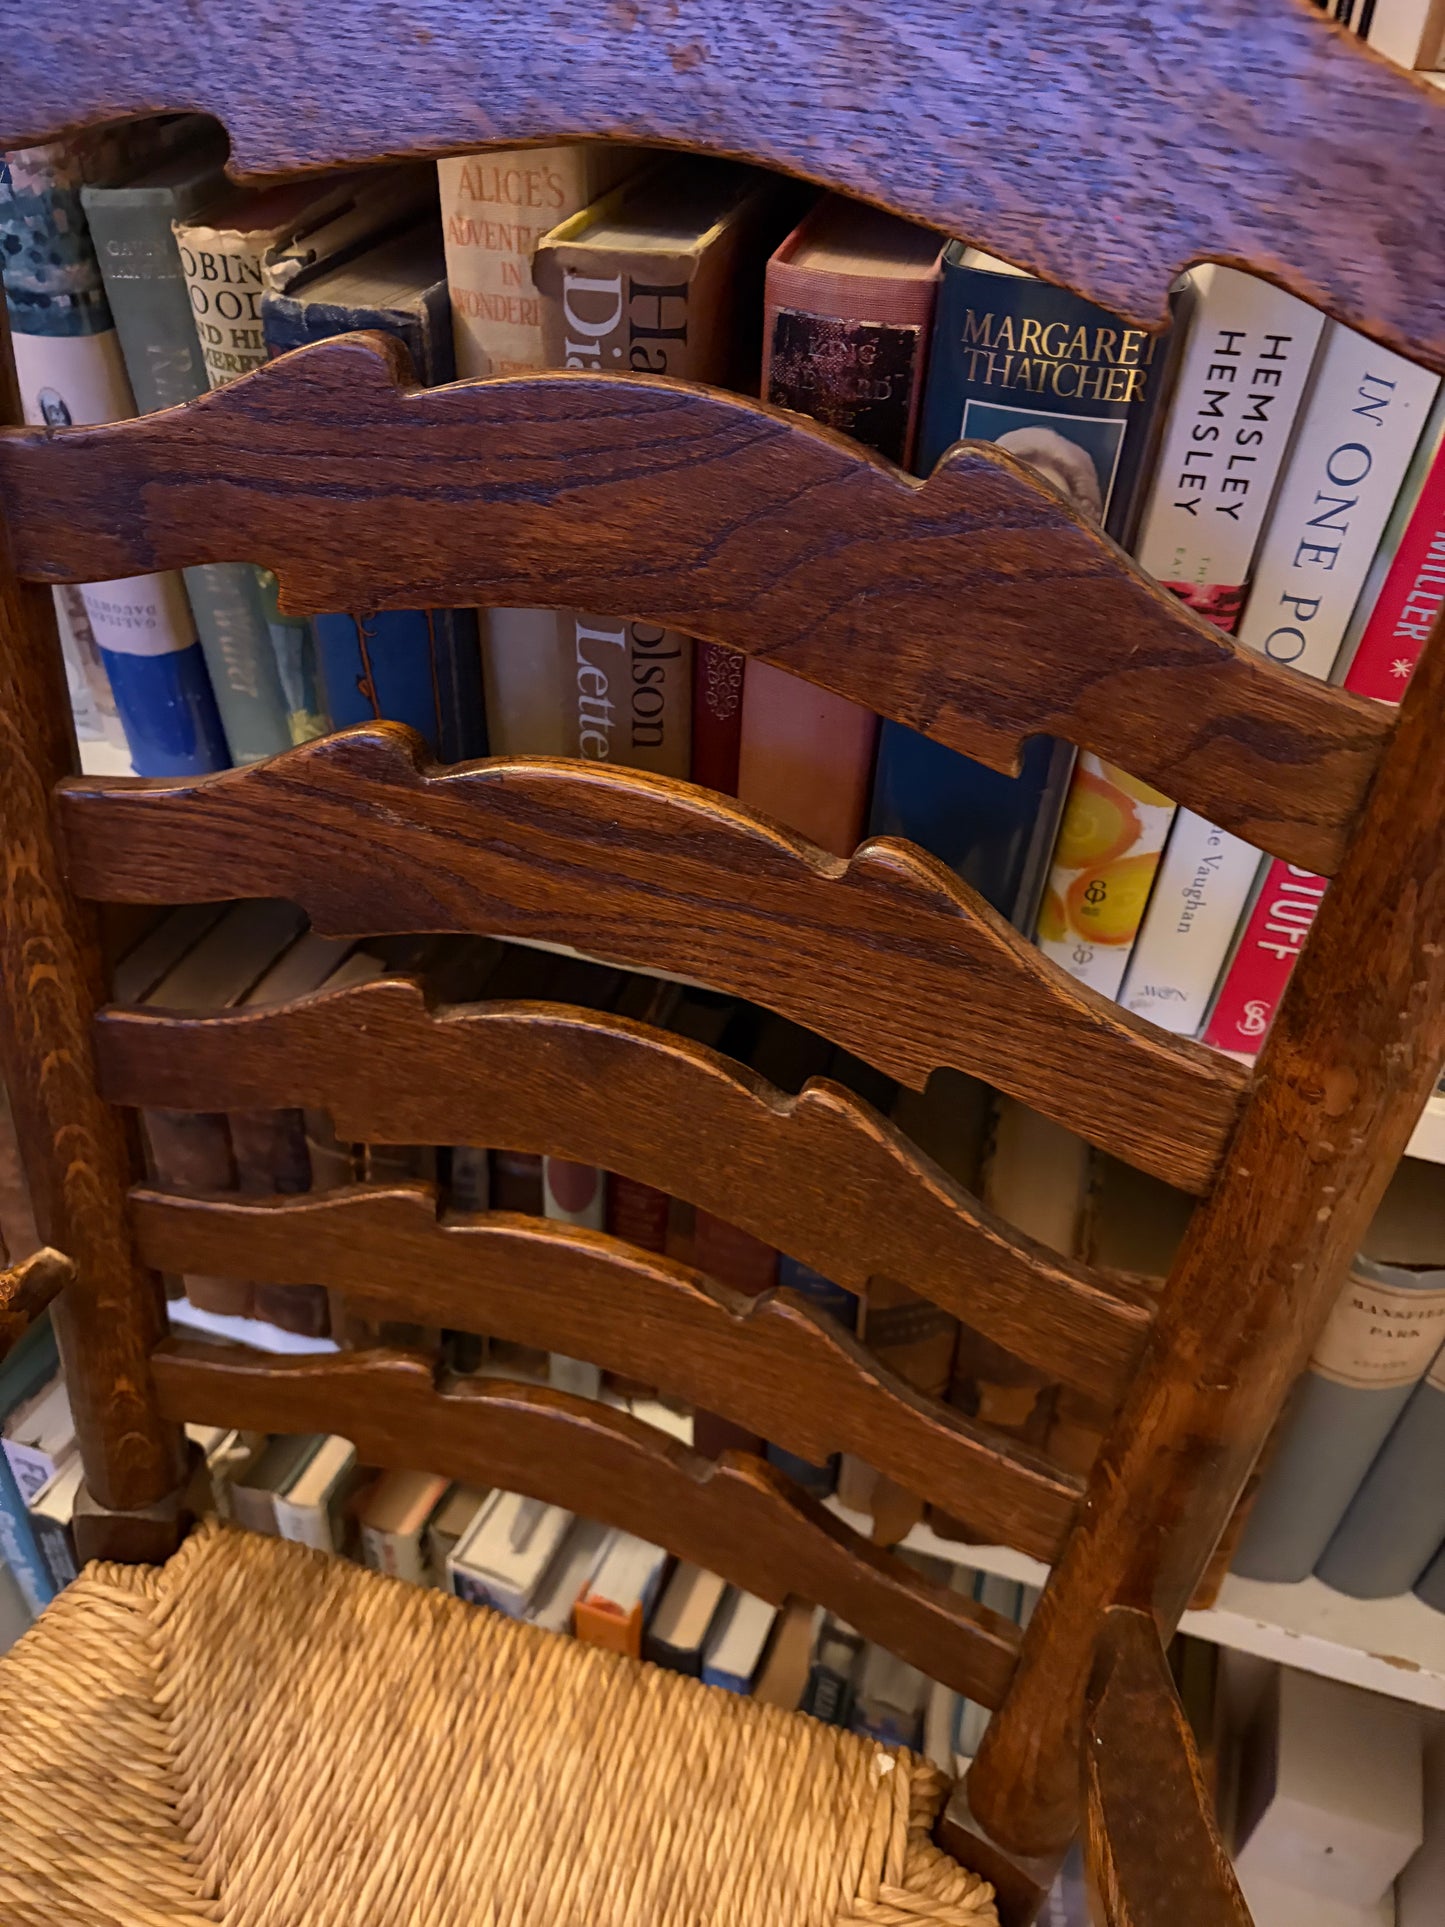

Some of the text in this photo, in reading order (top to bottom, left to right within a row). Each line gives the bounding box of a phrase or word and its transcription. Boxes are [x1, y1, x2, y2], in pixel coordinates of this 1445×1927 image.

[458, 164, 566, 210] ALICE'S
[501, 260, 523, 287] IN
[963, 346, 1148, 403] THATCHER
[1351, 373, 1397, 428] IN
[1173, 330, 1247, 516] HEMSLEY
[1215, 334, 1293, 520] HEMSLEY
[1294, 442, 1373, 571] ONE
[1176, 854, 1223, 934] Vaughan
